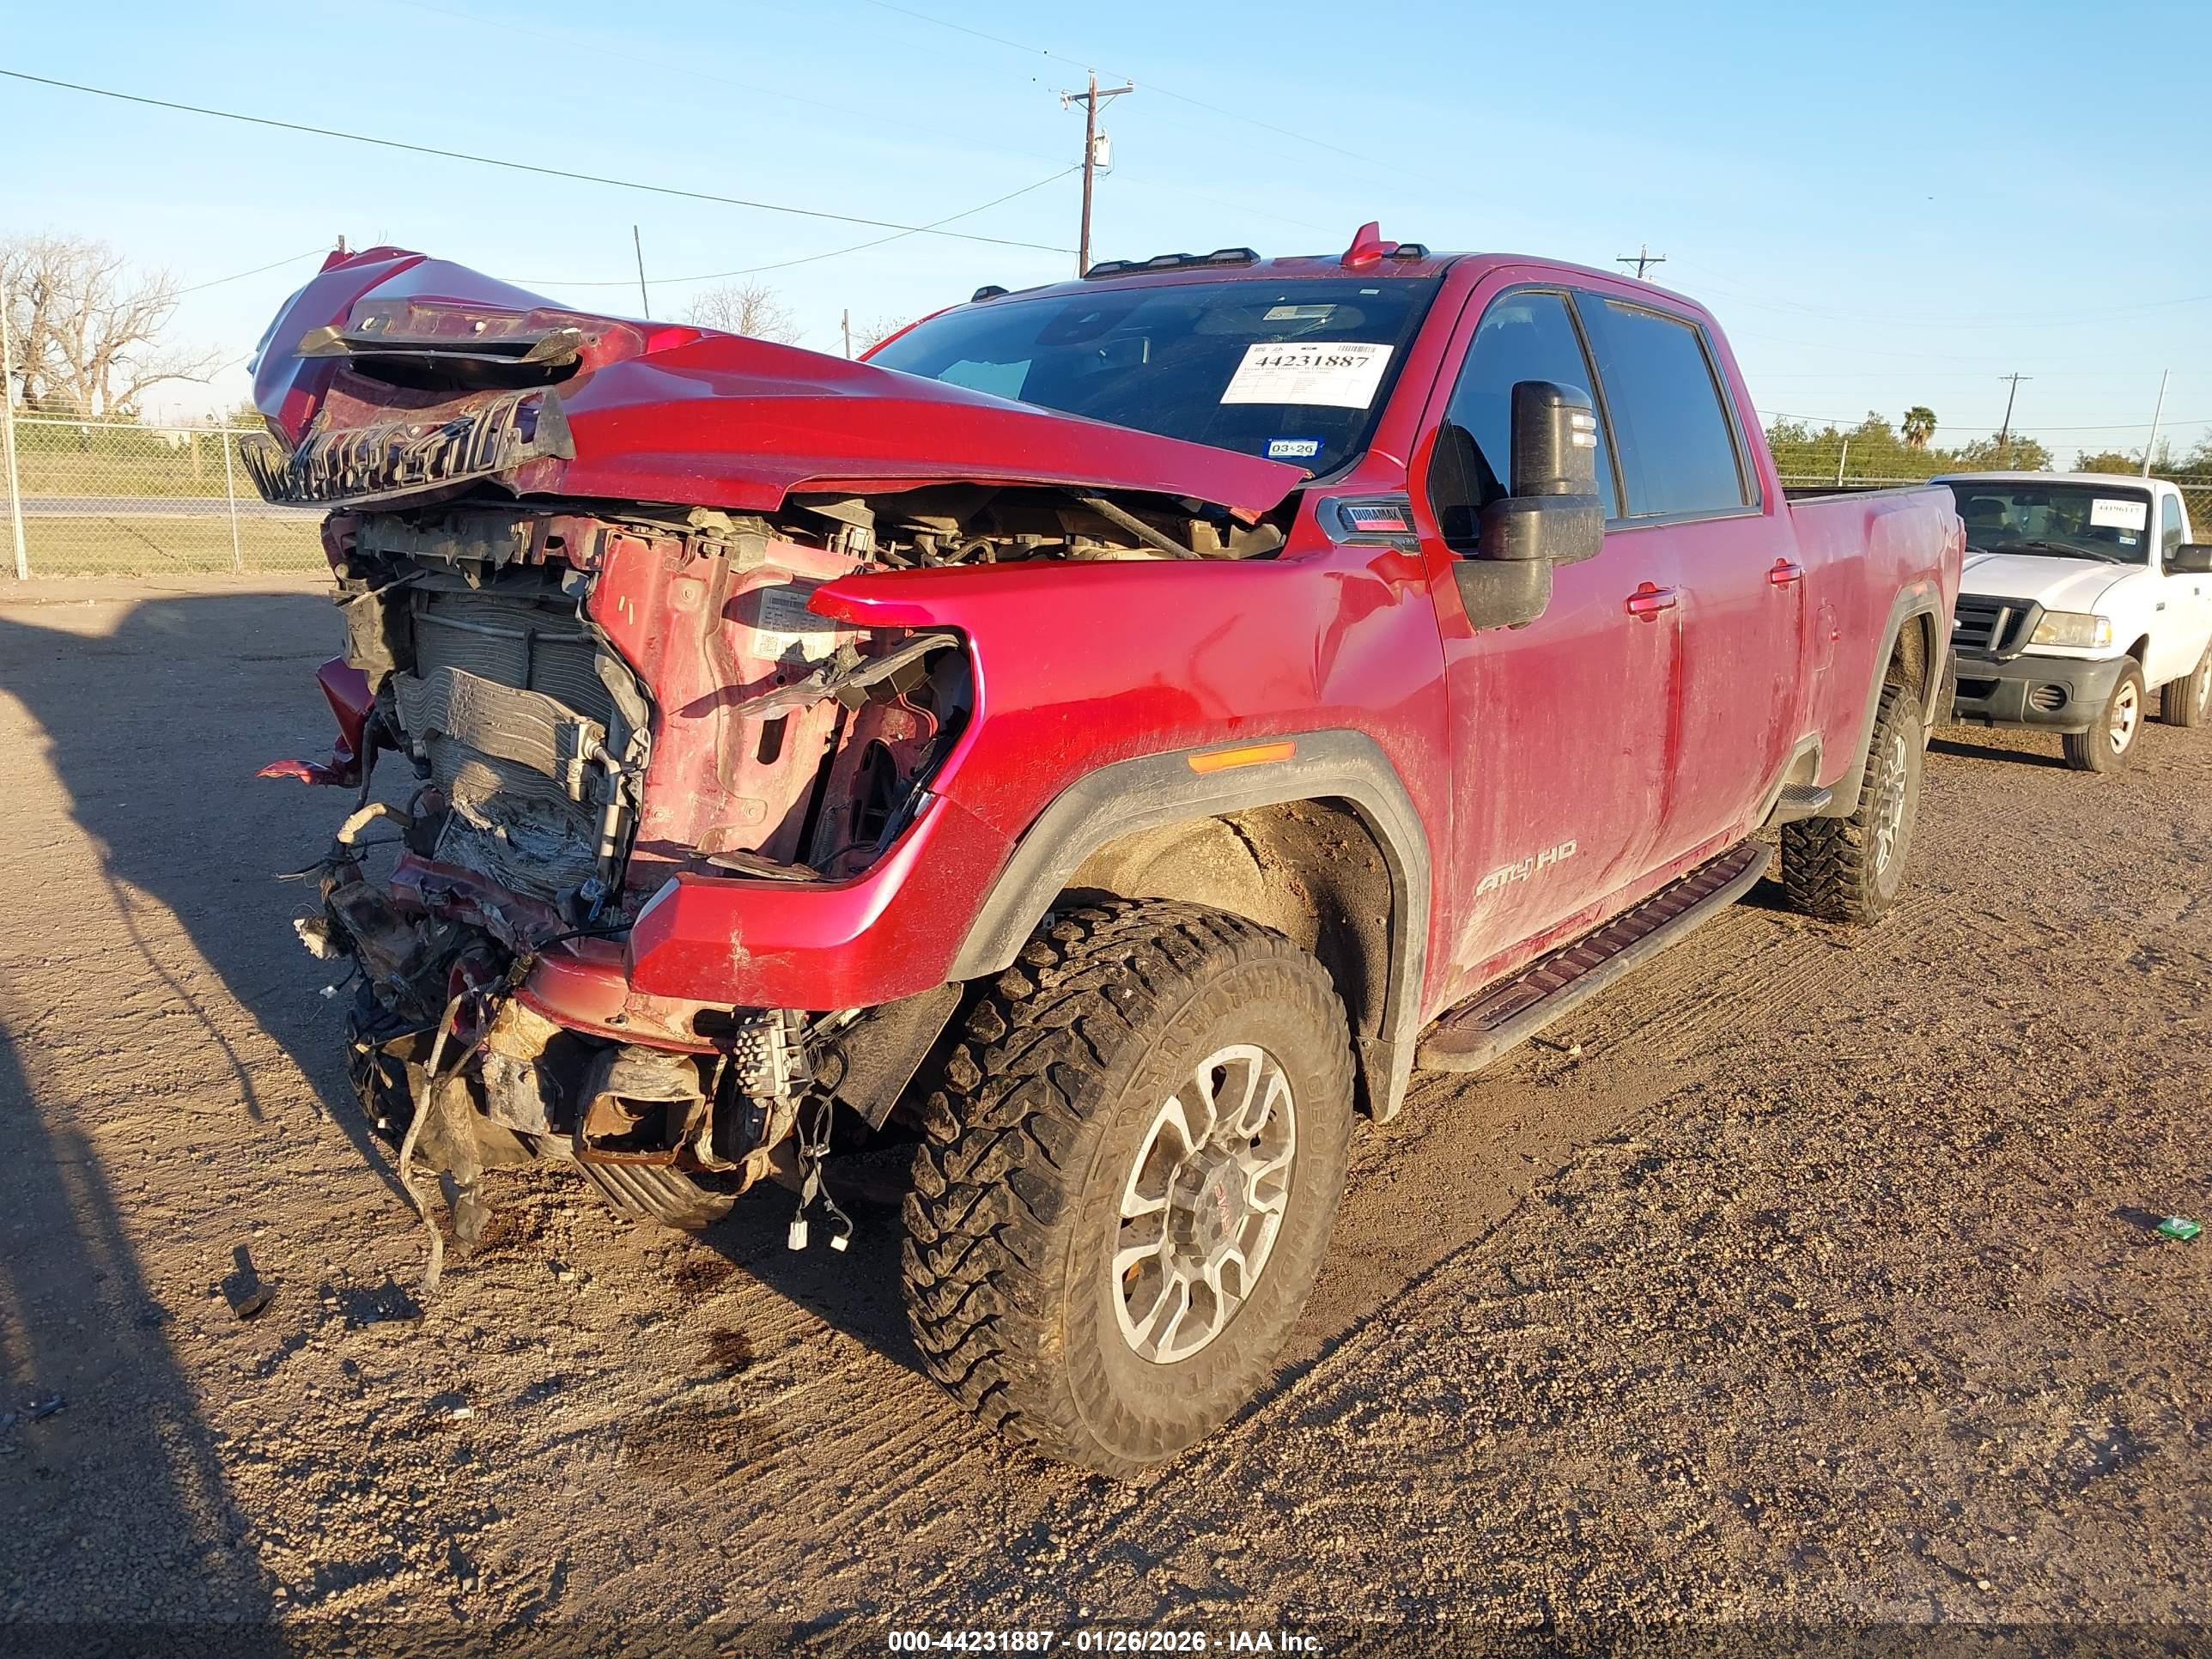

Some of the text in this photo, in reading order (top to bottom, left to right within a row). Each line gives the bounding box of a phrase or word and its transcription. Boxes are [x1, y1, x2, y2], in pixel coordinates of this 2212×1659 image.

[1255, 355, 1370, 368] 44231887
[1352, 508, 1400, 520] DURAMAX
[1474, 839, 1577, 896] AT4 HD
[1213, 1181, 1231, 1235] GMC
